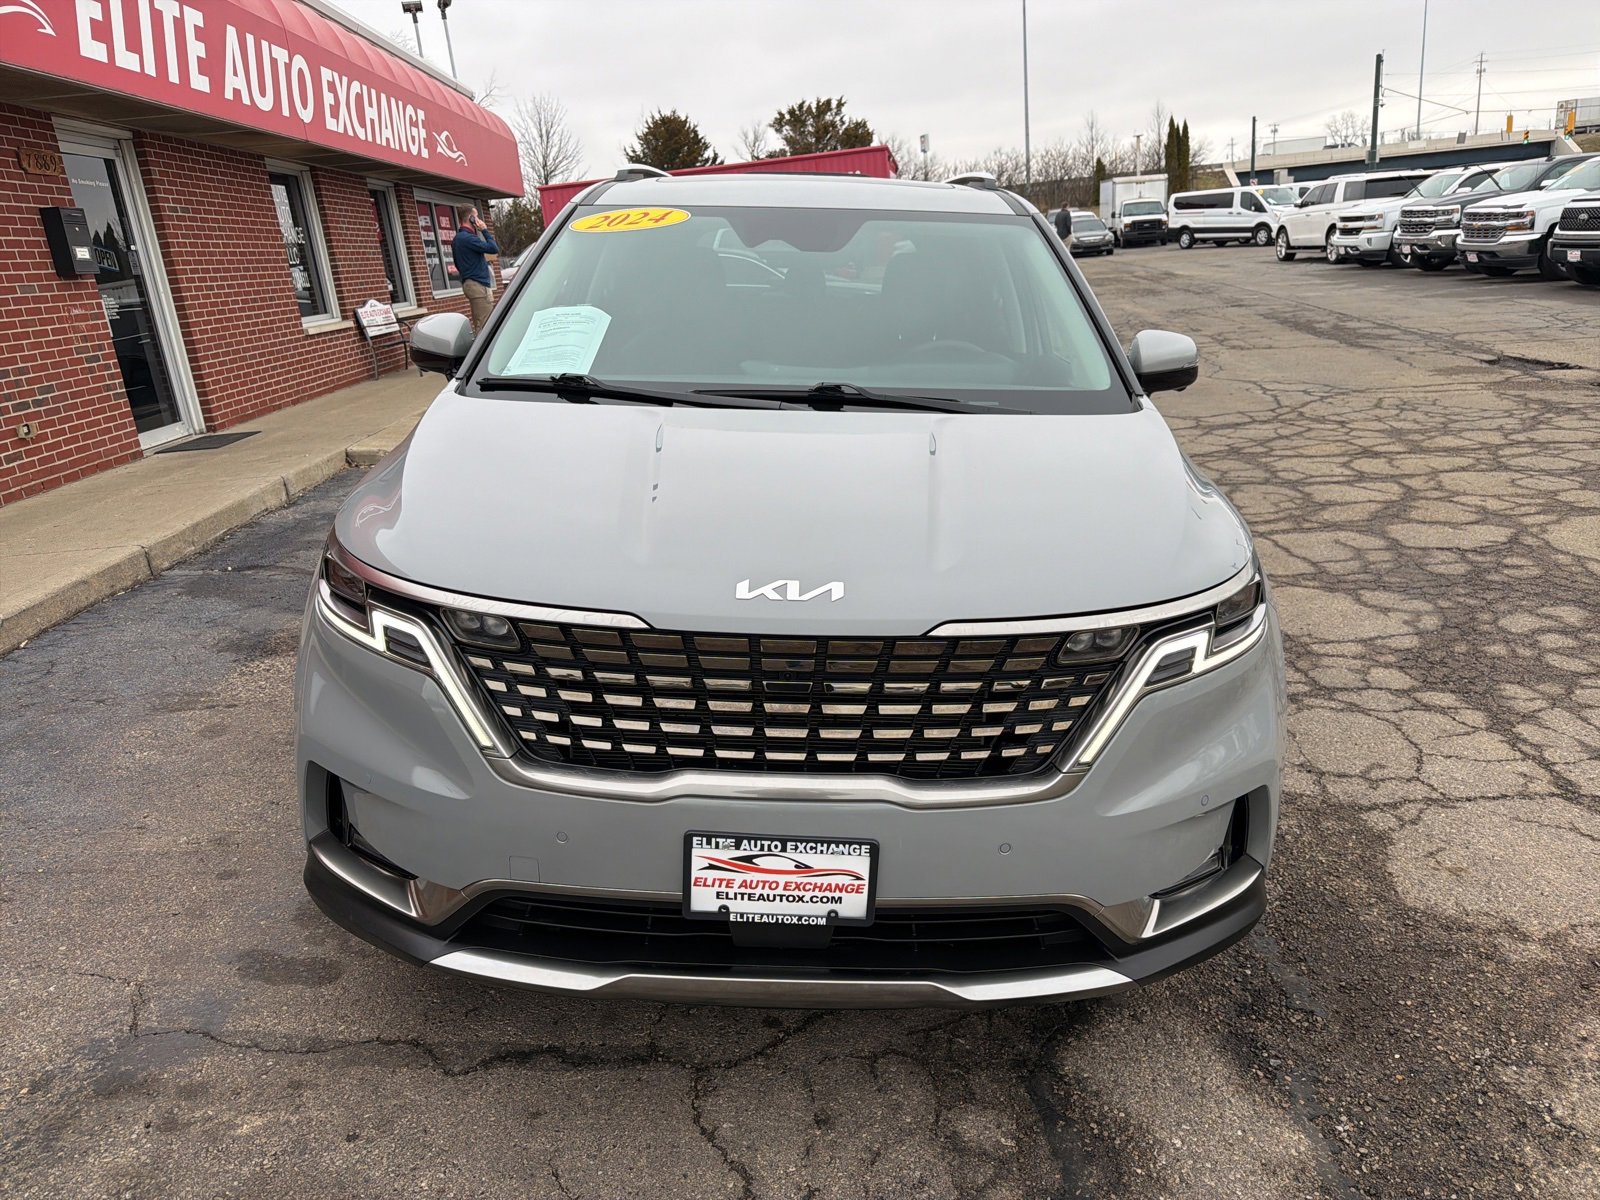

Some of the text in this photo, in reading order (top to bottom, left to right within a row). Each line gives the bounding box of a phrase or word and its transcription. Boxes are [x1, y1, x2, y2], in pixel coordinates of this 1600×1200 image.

[75, 0, 430, 158] ELITE AUTO EXCHANGE
[25, 153, 57, 172] 7889
[585, 210, 674, 230] 2024
[95, 249, 117, 270] OPEN
[735, 579, 845, 602] KIA
[693, 837, 870, 857] ELITE AUTO EXCHANGE
[693, 877, 866, 894] ELITE AUTO EXCHANGE
[716, 891, 843, 905] ELITEAUTOX.COM
[730, 913, 827, 926] ELITEAUTOX.COM
